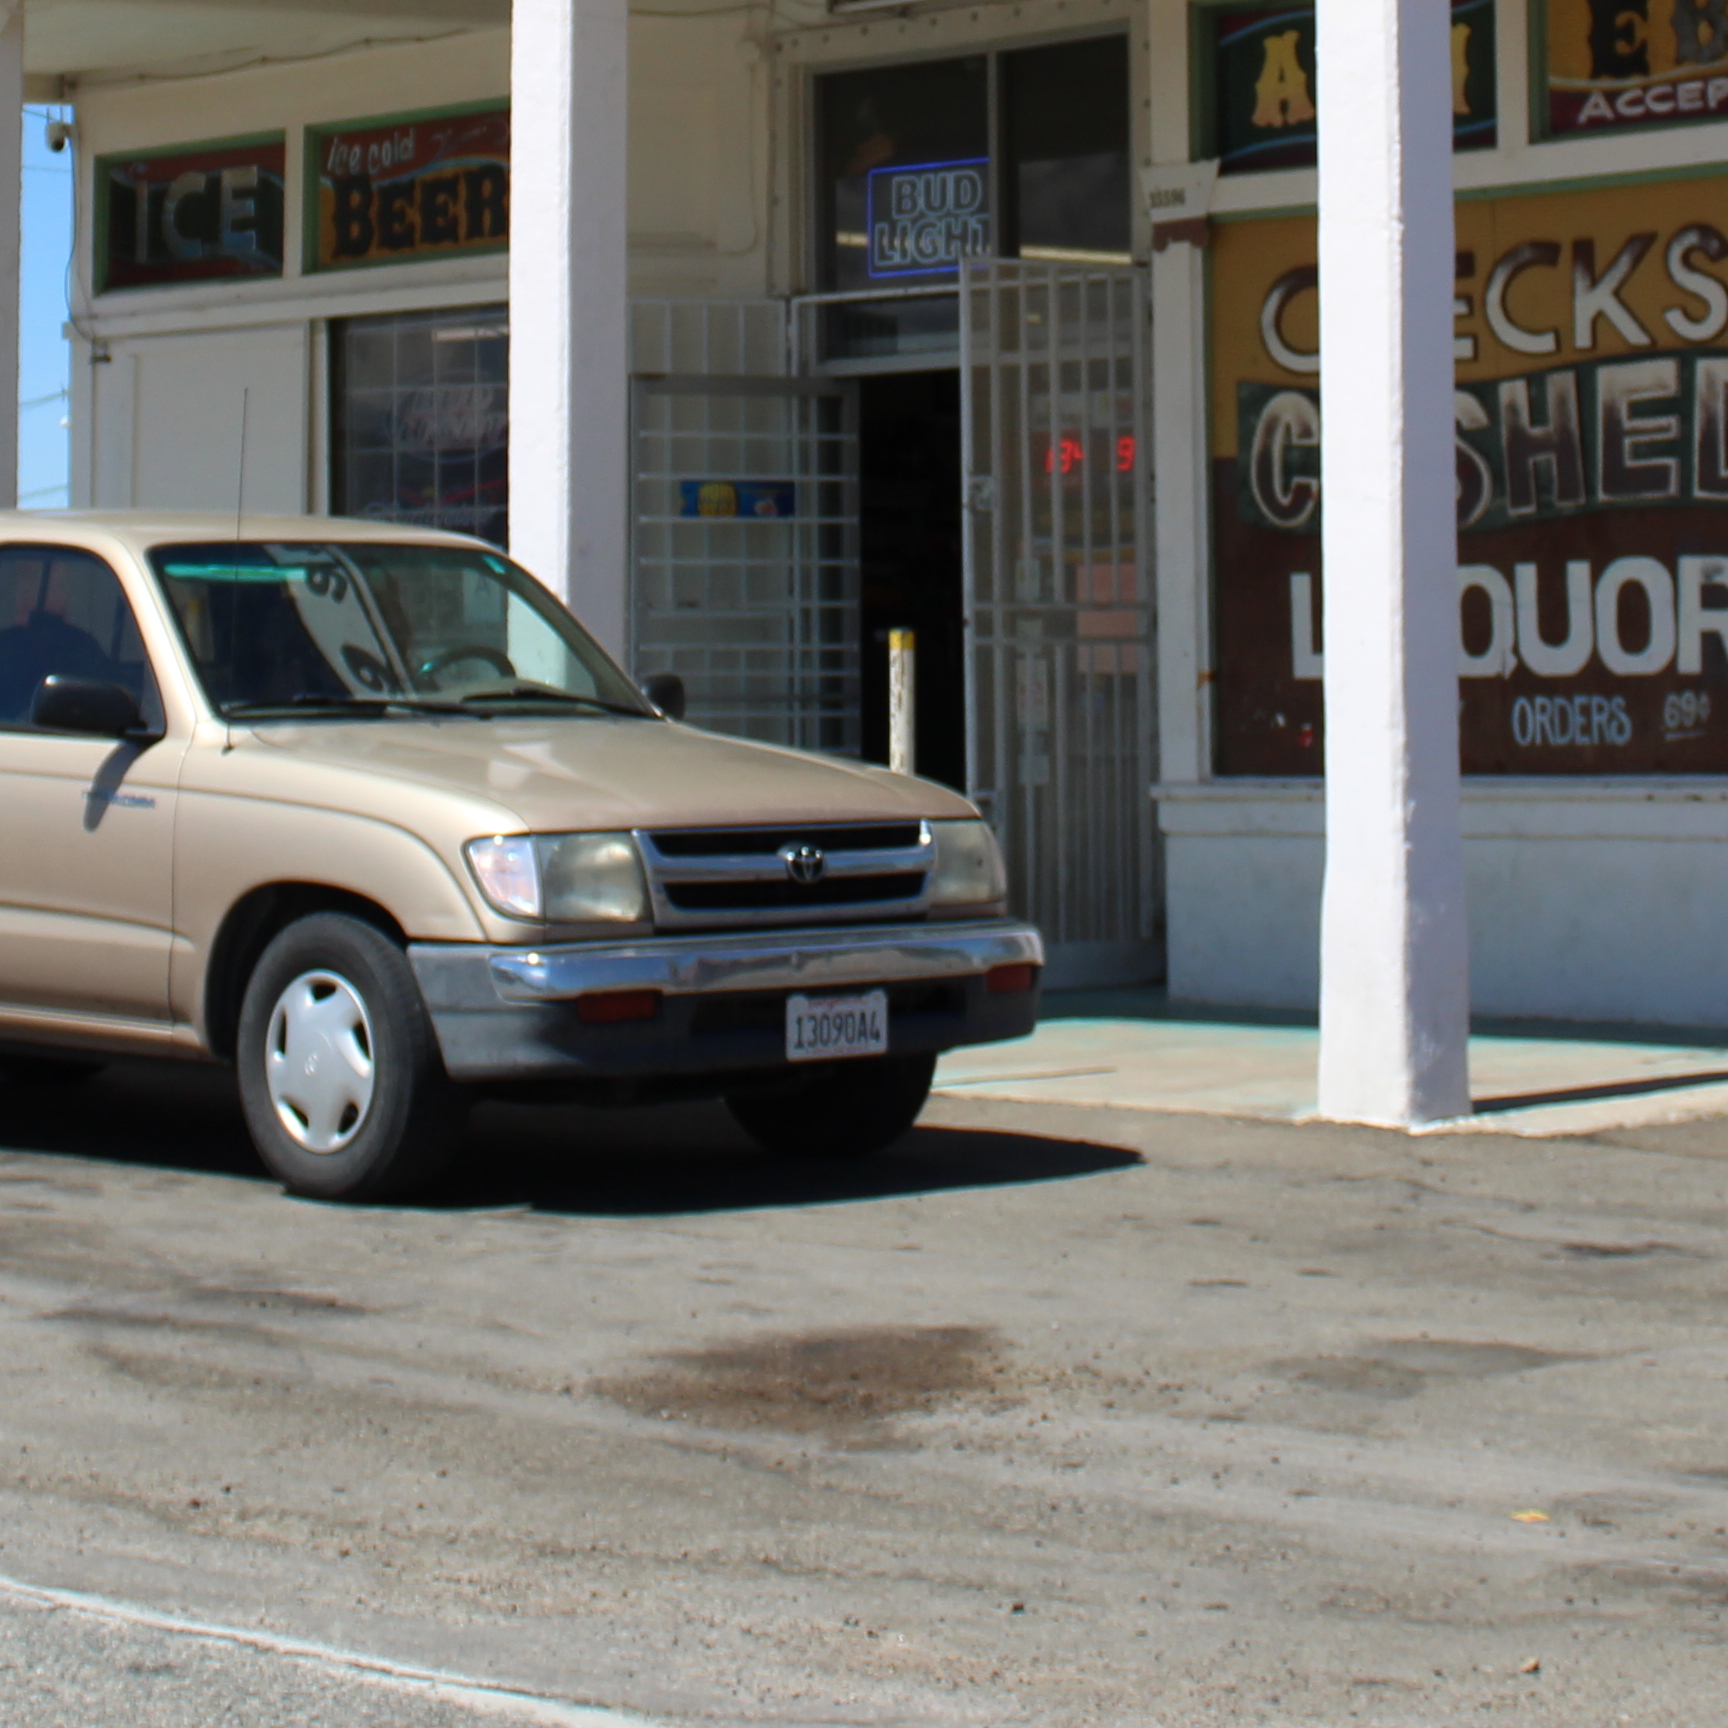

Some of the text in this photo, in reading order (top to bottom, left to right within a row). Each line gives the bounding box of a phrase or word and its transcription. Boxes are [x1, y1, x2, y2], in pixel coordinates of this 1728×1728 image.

[135, 164, 258, 264] ICE
[330, 163, 508, 260] BEER
[892, 169, 982, 219] BUD
[1511, 693, 1633, 747] ORDERS
